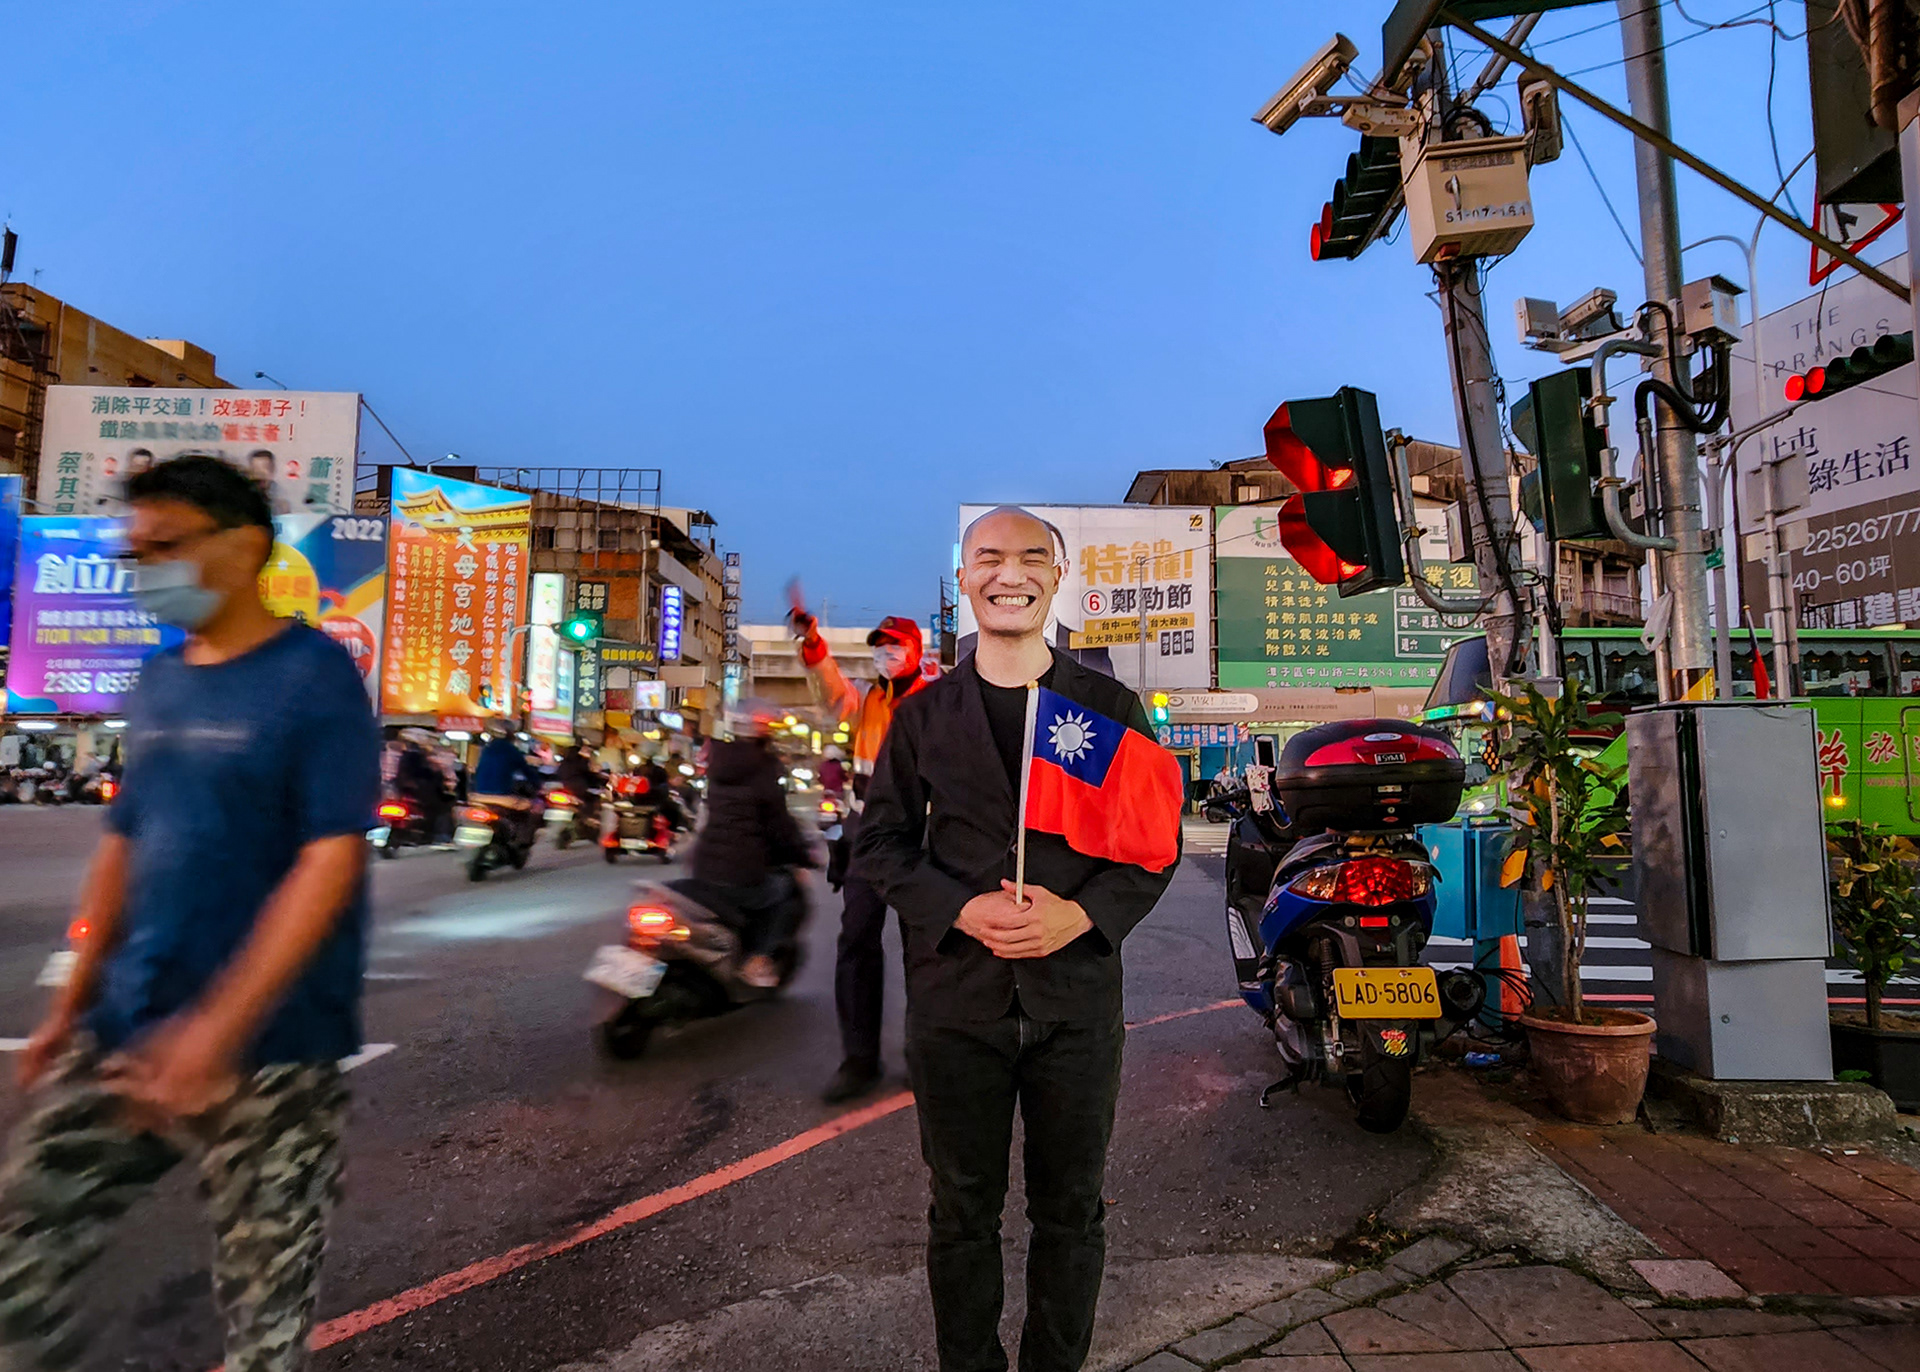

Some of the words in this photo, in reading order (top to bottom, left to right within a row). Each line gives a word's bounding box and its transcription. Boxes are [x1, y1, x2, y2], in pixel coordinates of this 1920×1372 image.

[1791, 306, 1840, 340] THE
[1763, 318, 1890, 381] PRINGS
[1809, 435, 1911, 494] 綠生活
[331, 517, 383, 541] 2022
[1405, 566, 1475, 588] 業復
[578, 597, 605, 610] 快修
[1111, 583, 1192, 614] 鄭勁節
[1264, 596, 1328, 608] 精準徒手
[1265, 612, 1379, 625] 骨骼肌肉超音波
[1265, 628, 1362, 641] 體外震波治療
